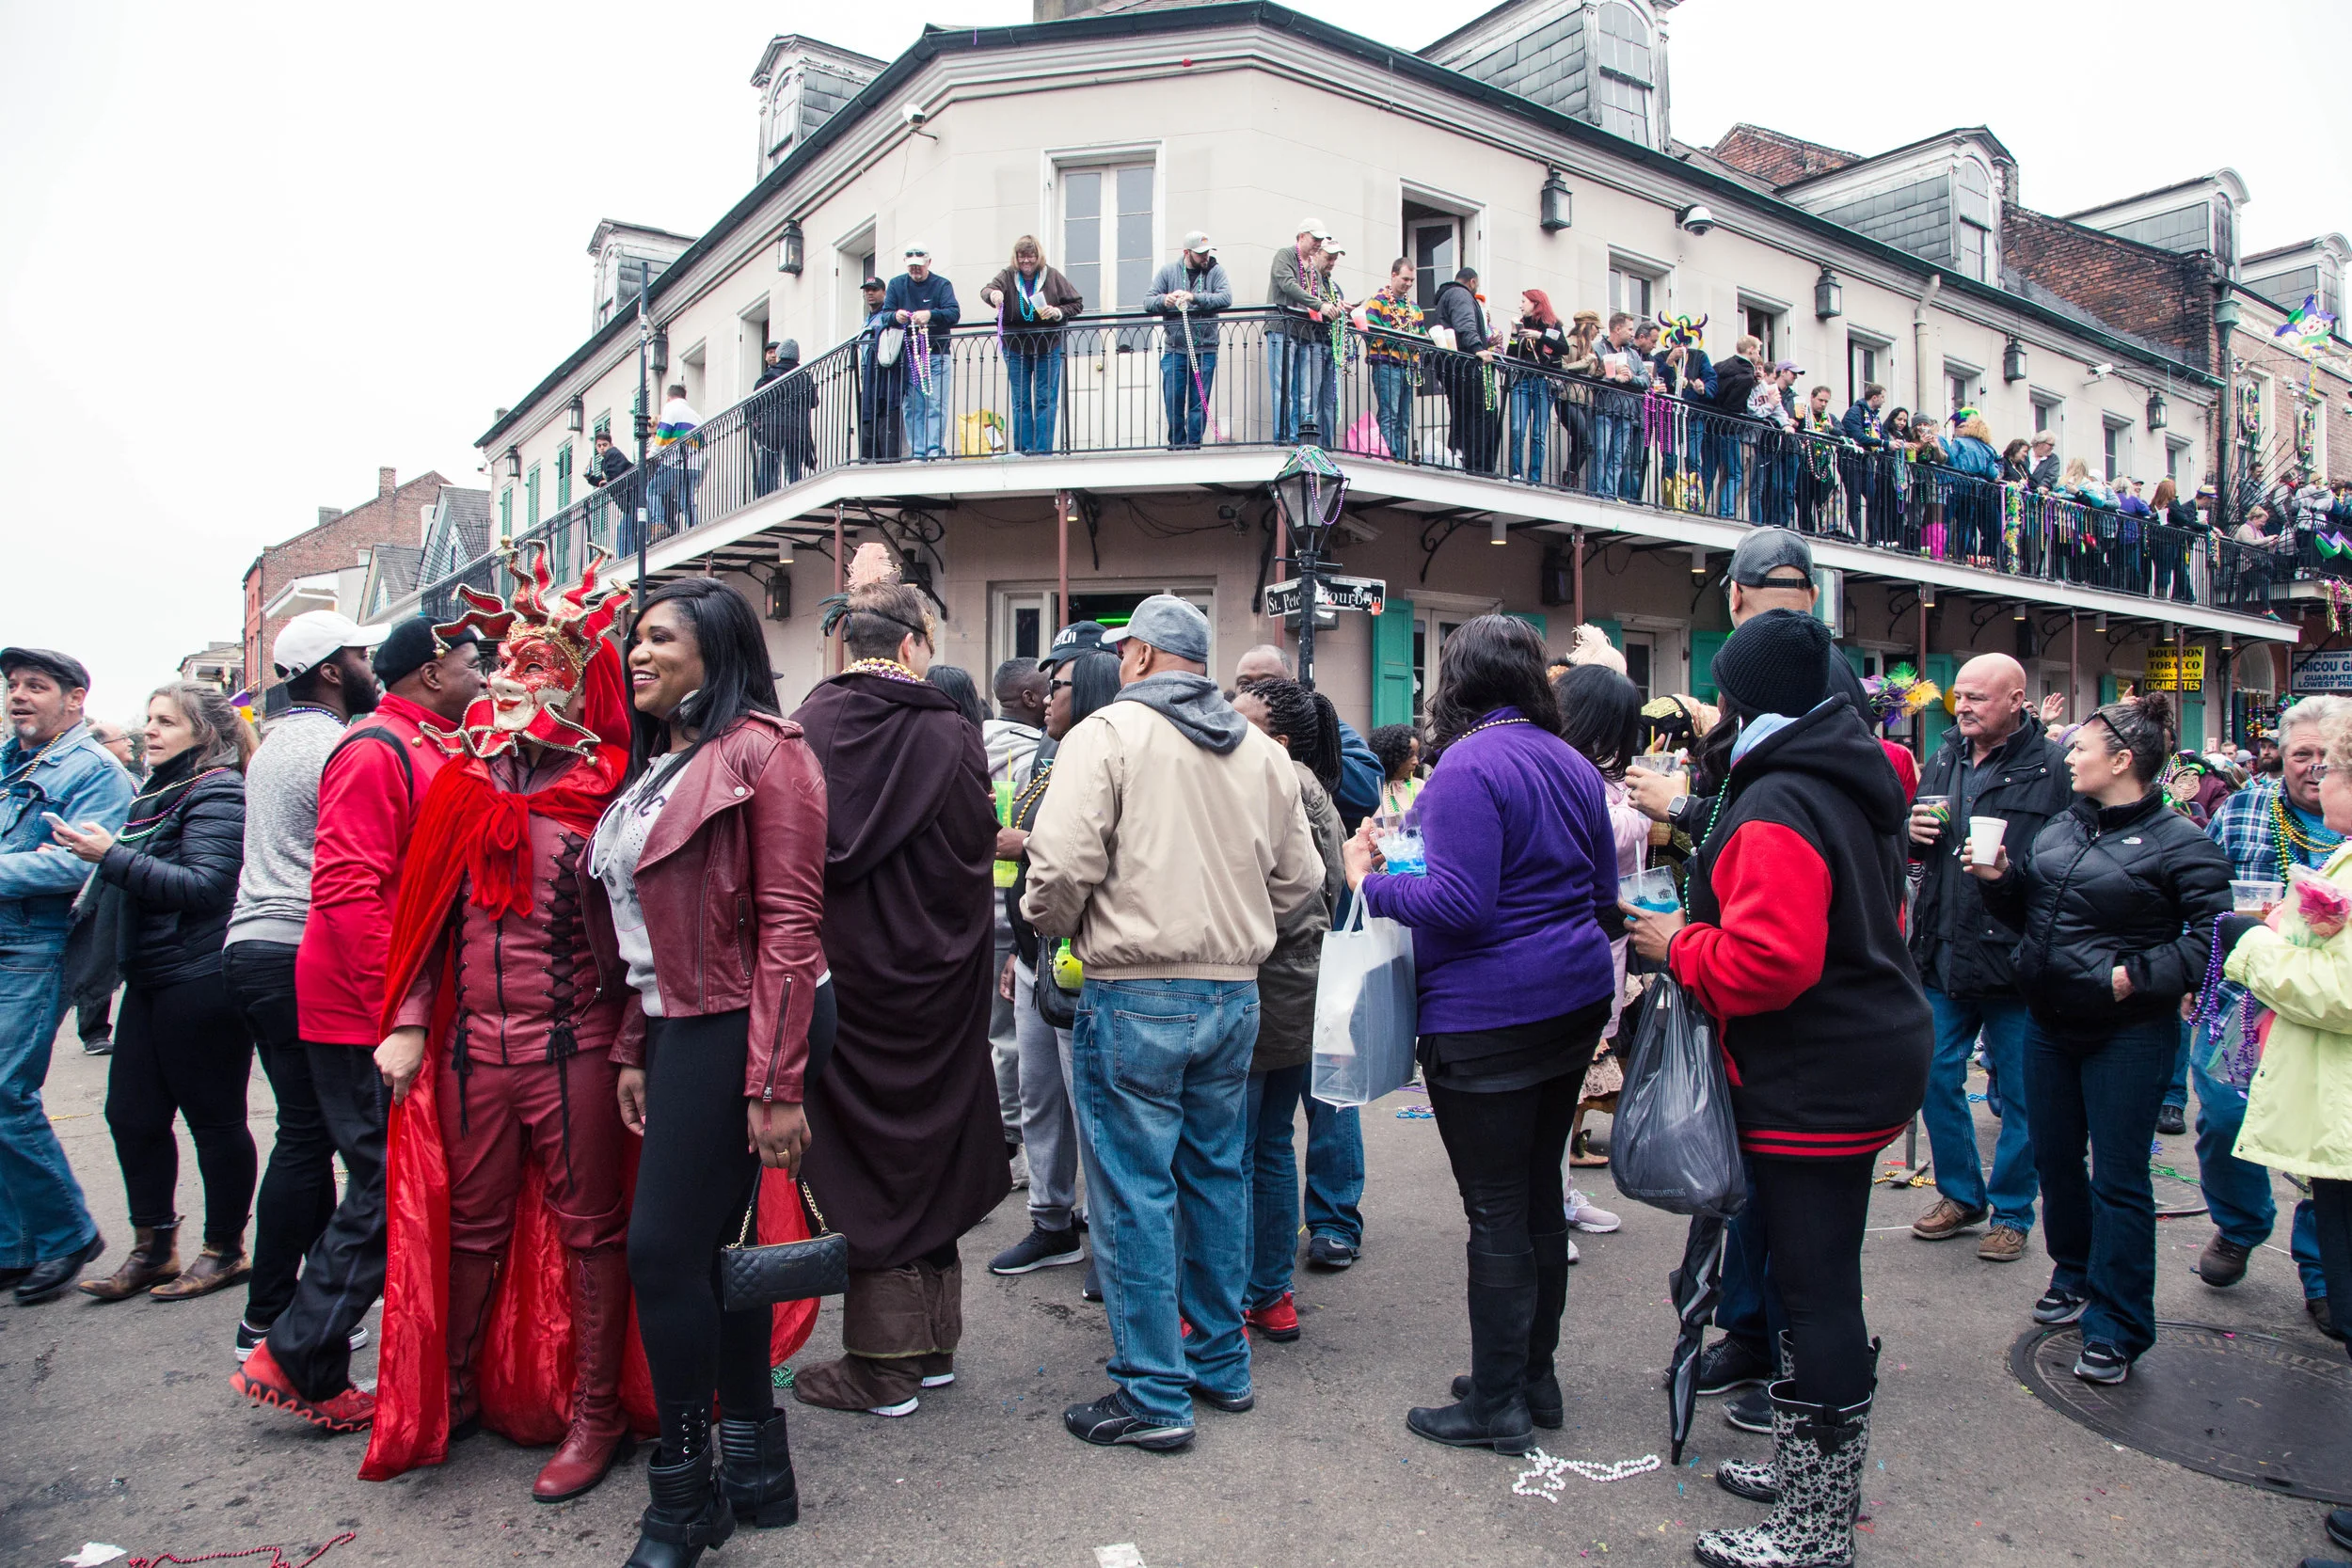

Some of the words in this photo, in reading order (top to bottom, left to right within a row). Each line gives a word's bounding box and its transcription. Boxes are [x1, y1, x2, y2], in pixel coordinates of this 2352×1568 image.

[1269, 596, 1281, 611] St.
[1282, 590, 1303, 609] Pete
[2150, 660, 2201, 670] TOBACO
[2146, 680, 2201, 690] CIGARETES
